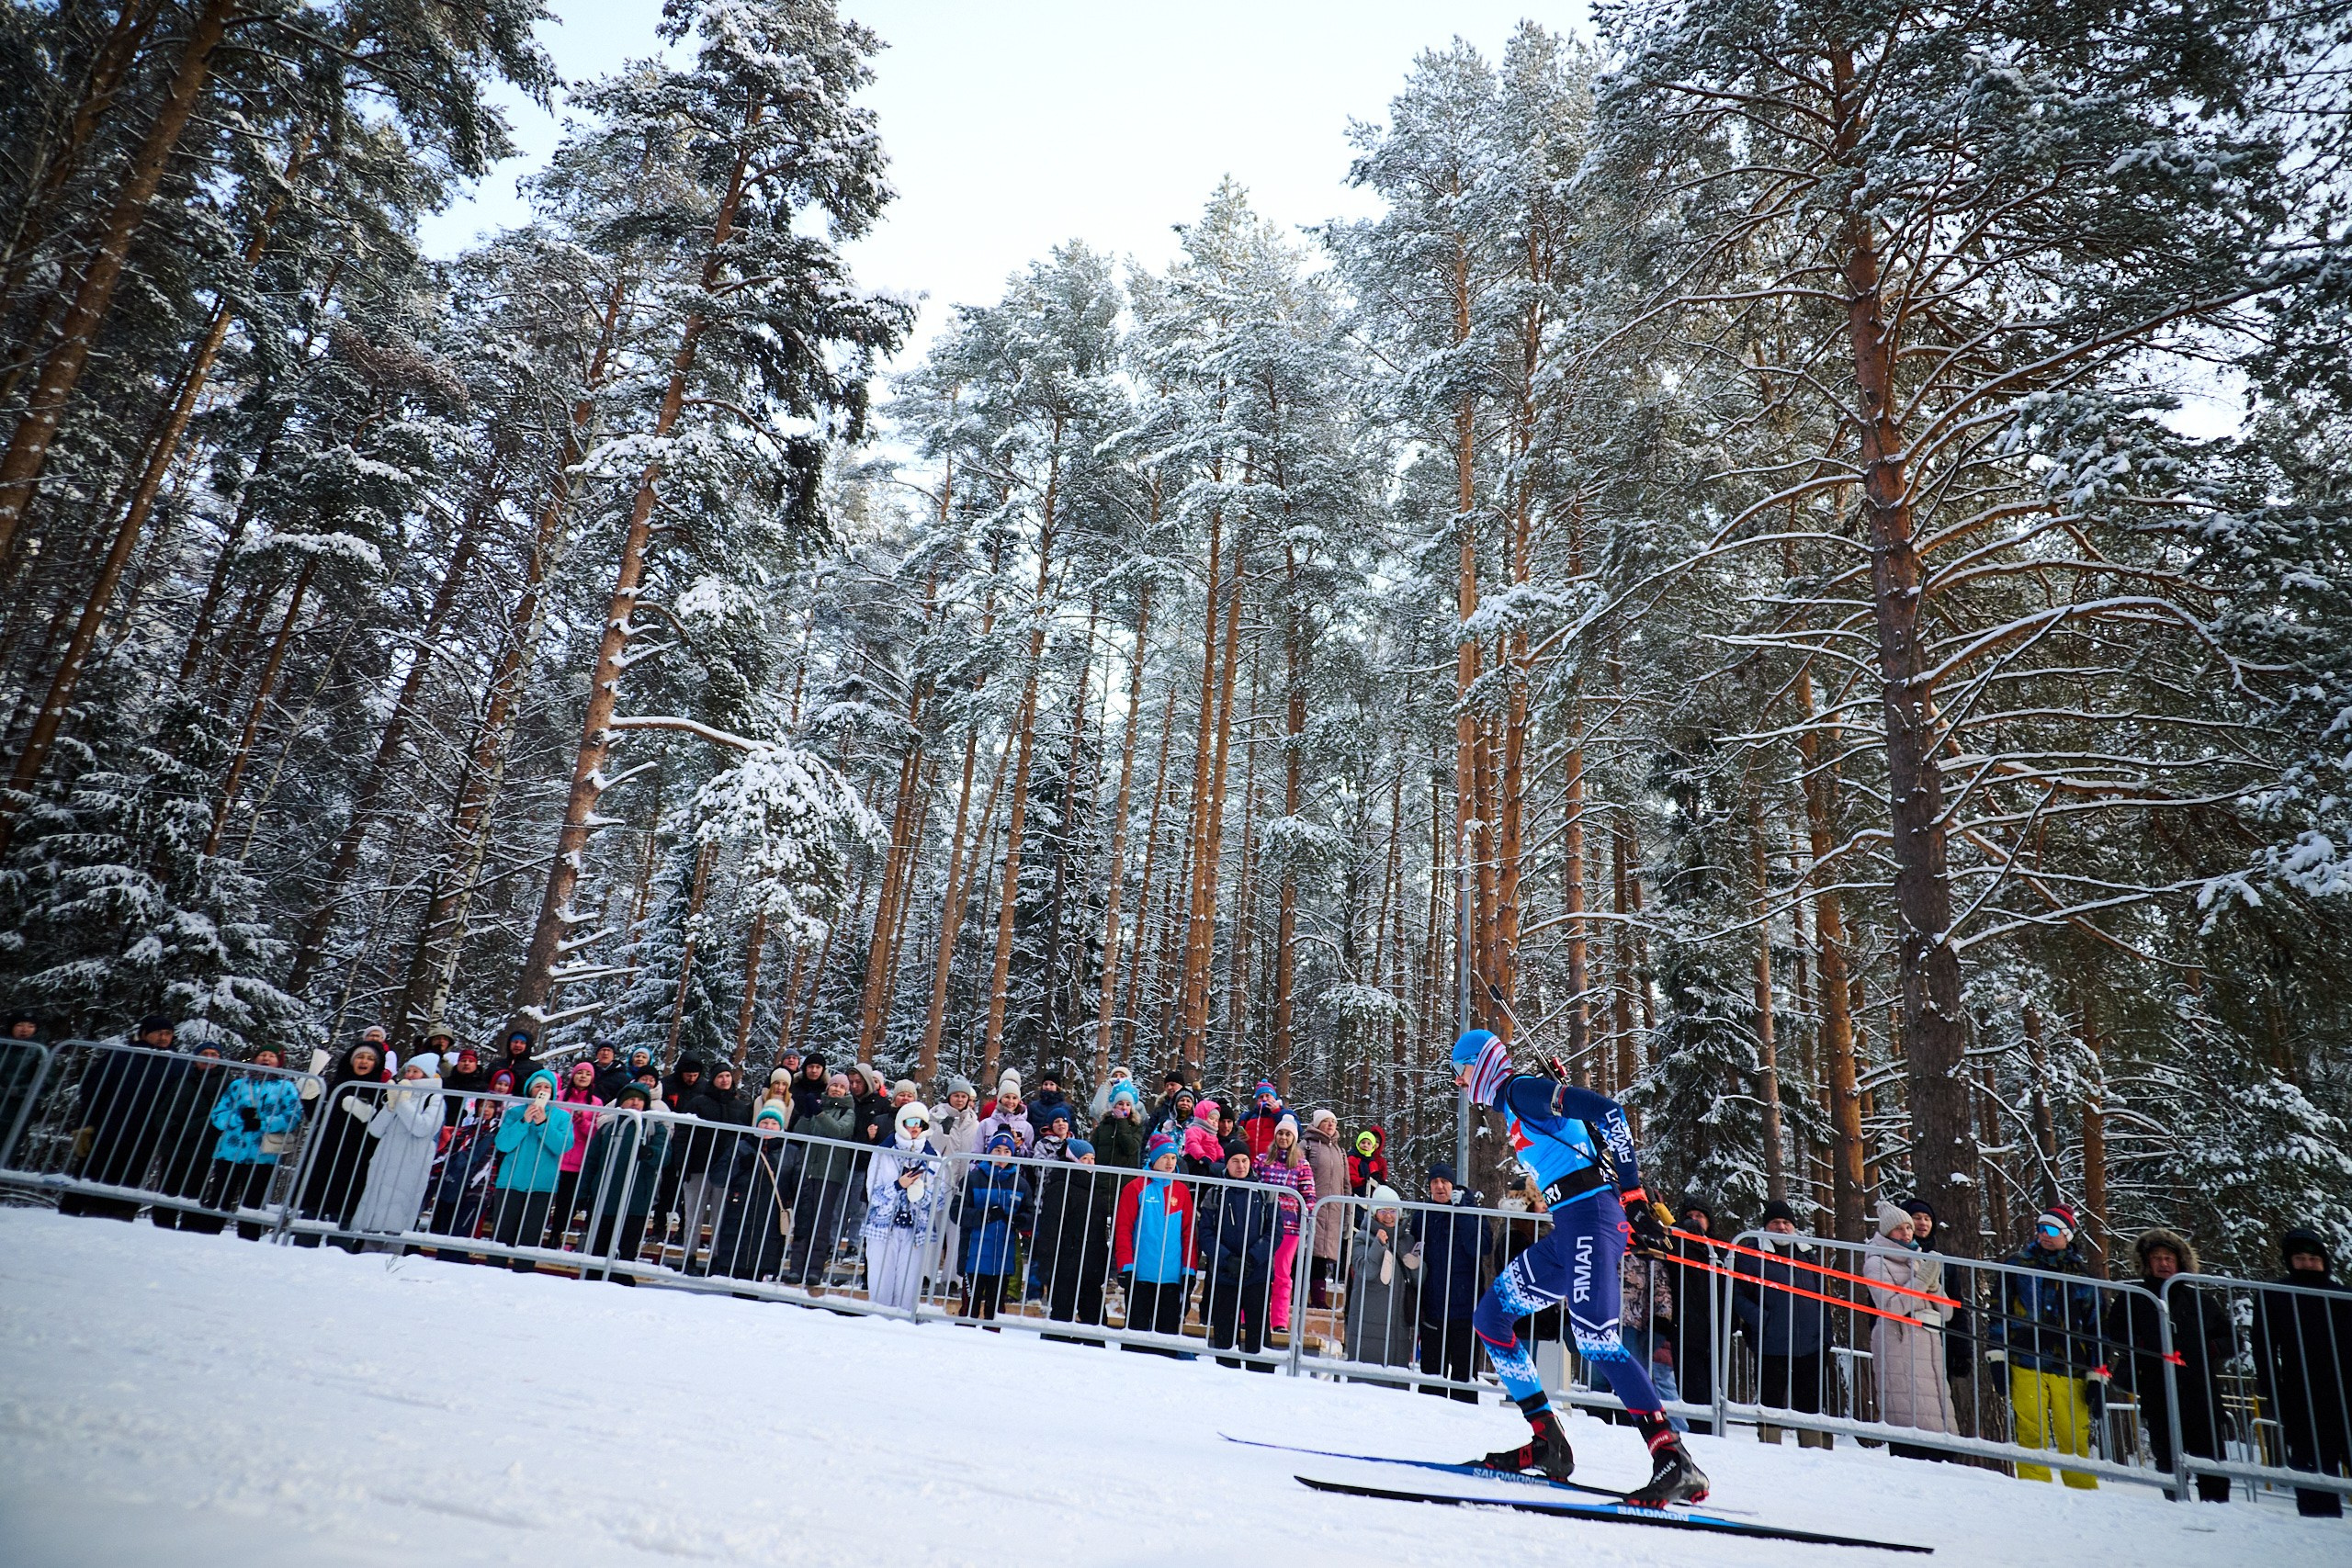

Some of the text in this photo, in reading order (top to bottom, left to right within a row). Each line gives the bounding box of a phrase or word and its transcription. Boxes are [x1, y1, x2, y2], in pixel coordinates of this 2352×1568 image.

[1605, 1108, 1633, 1164] ЯМАЛ
[1574, 1235, 1593, 1303] ЯМАЛ
[1473, 1467, 1535, 1483] SALOMON
[1617, 1506, 1690, 1522] SALOMON
